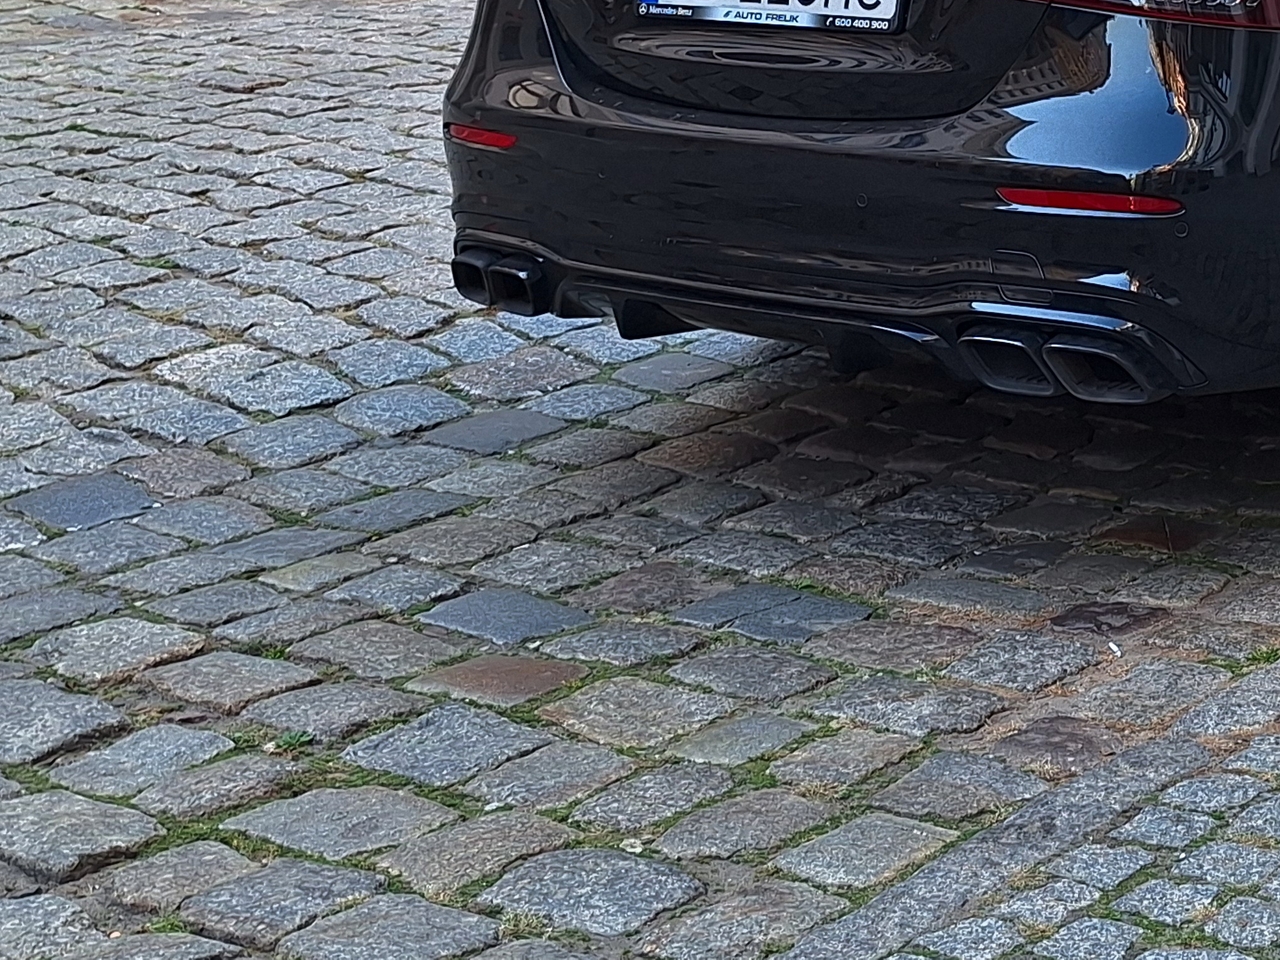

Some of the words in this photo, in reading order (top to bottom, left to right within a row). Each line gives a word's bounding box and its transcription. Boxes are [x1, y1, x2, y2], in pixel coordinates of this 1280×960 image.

[648, 5, 693, 16] Mercedes-Benz
[733, 10, 763, 22] AUTO
[834, 18, 851, 28] 600
[852, 19, 870, 29] 400
[871, 20, 889, 30] 900
